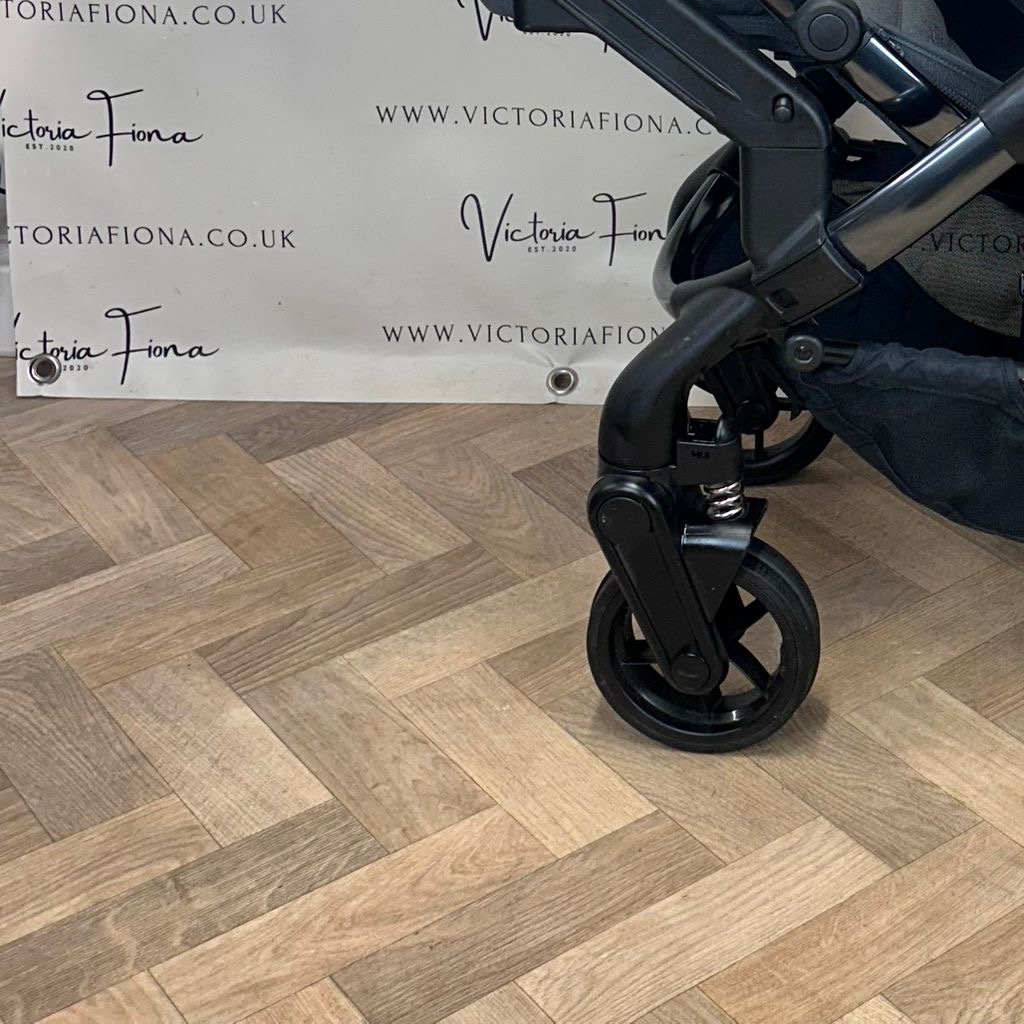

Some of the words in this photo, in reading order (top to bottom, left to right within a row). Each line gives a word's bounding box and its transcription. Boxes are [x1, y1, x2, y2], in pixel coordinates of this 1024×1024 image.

[25, 143, 74, 151] EST.2020
[87, 89, 203, 166] Fiona
[7, 225, 296, 249] TORIAFIONA.CO.UK
[460, 193, 595, 262] Victoria
[105, 305, 220, 385] Fiona
